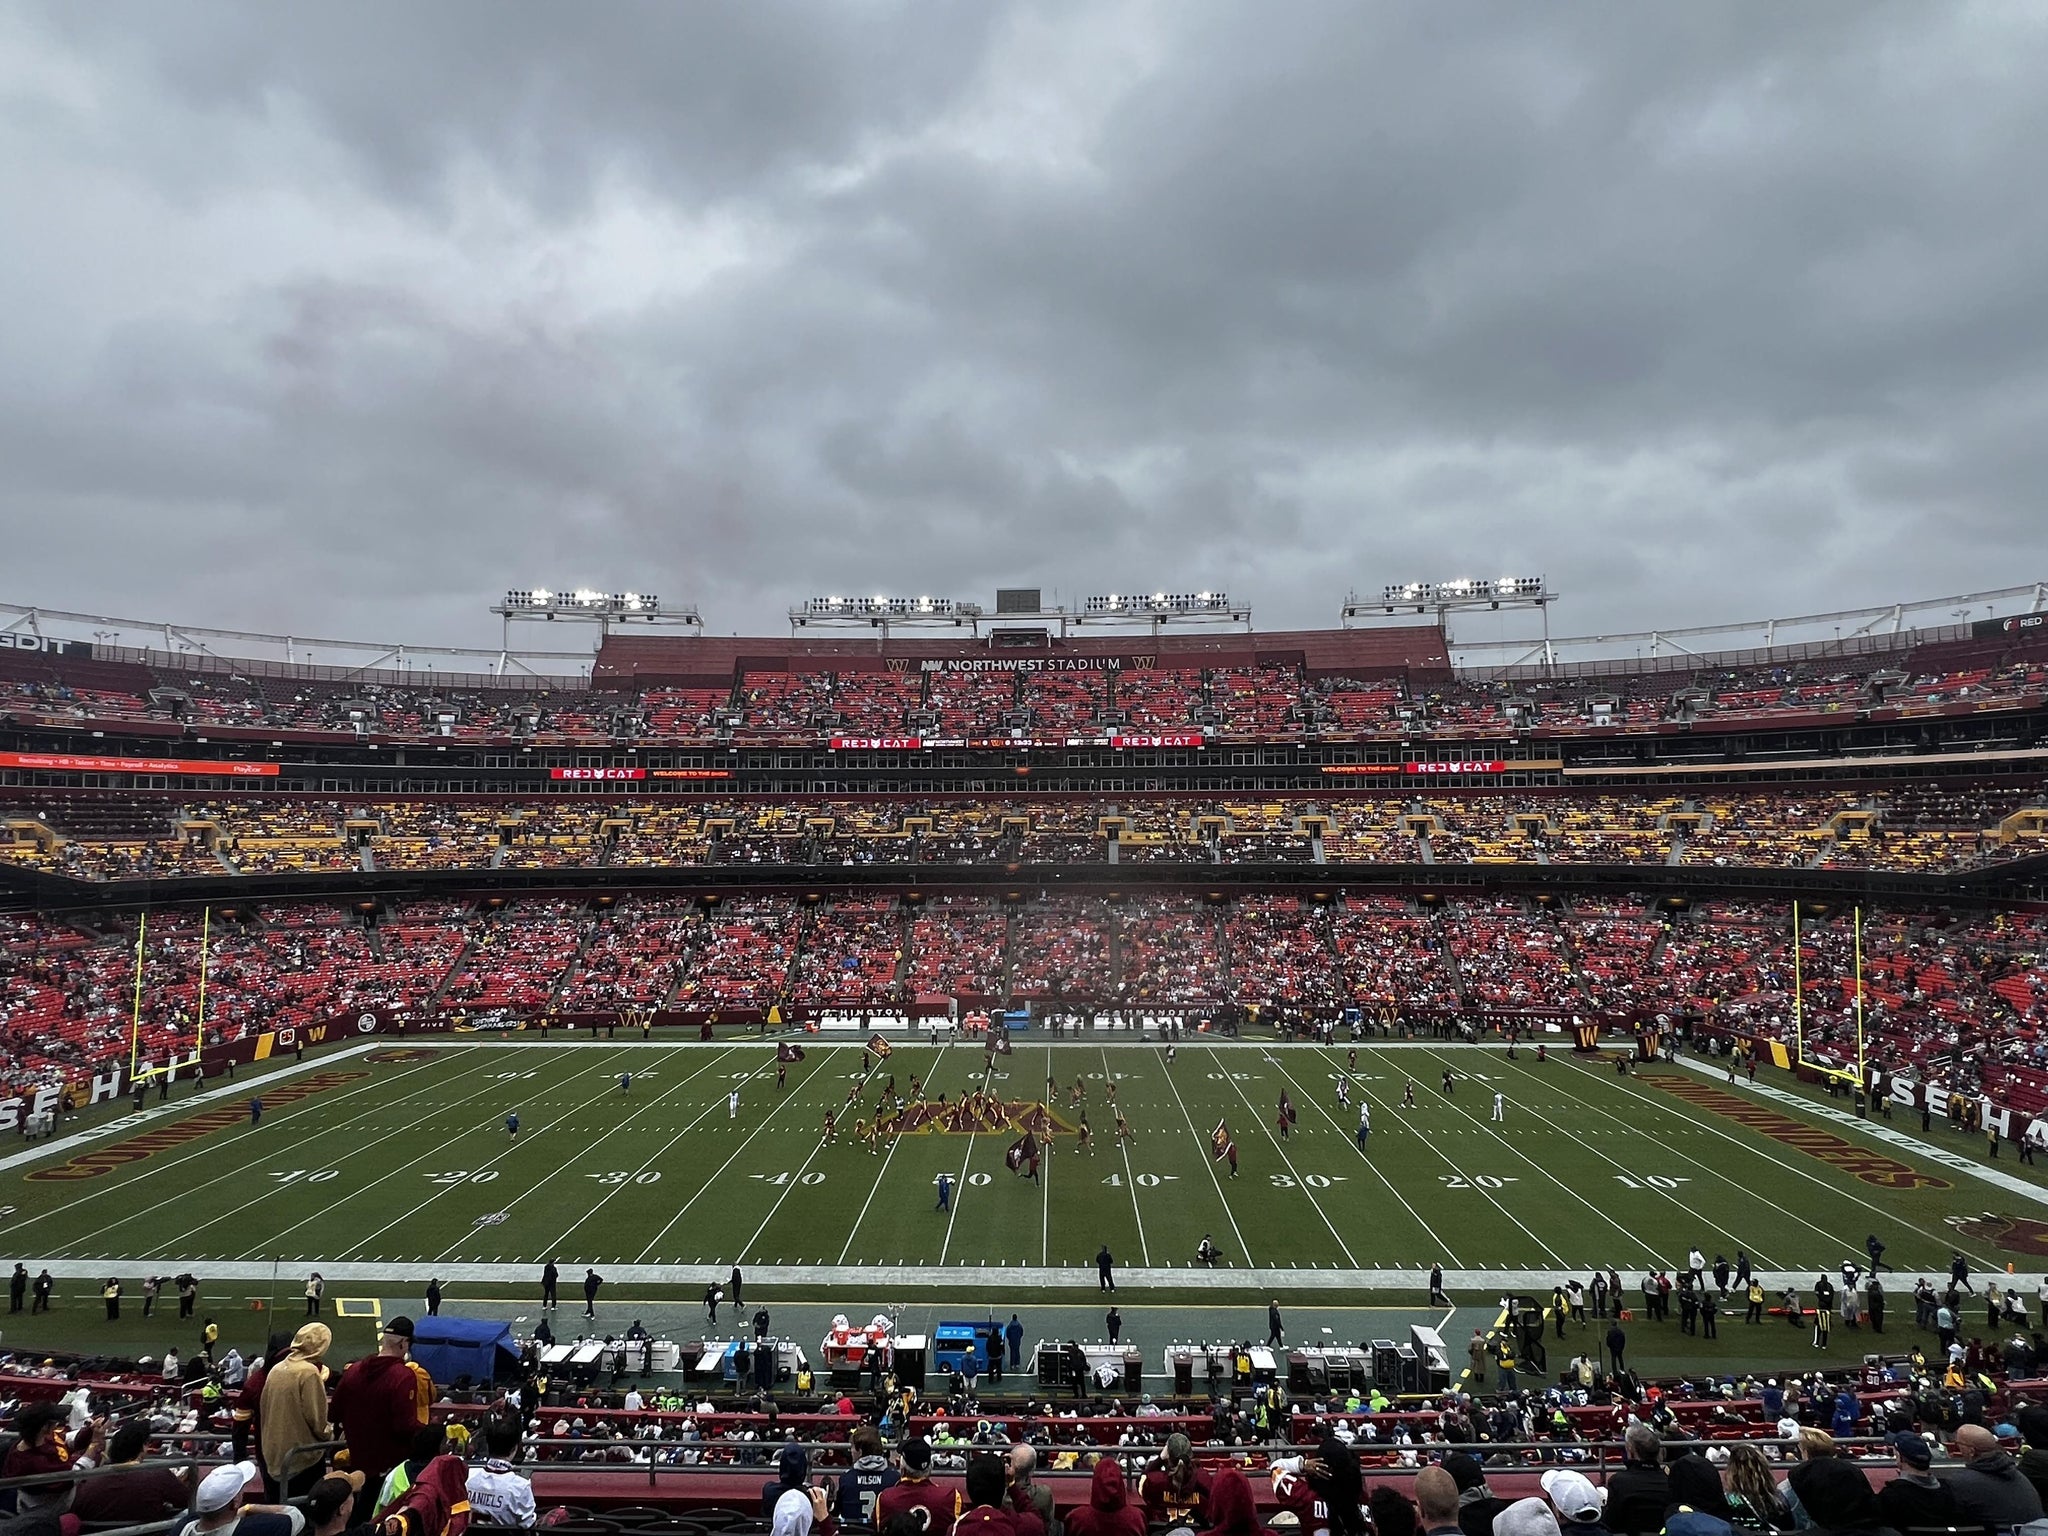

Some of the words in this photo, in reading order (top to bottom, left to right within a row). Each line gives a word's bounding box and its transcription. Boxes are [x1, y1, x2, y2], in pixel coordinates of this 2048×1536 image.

[0, 631, 71, 654] GDIT
[948, 659, 1044, 671] NORTHWEST
[1048, 657, 1120, 670] STADIUM
[842, 739, 868, 748] RED
[883, 739, 909, 748] CAT
[1122, 737, 1148, 746] RED
[1164, 737, 1191, 746] CAT
[563, 769, 591, 779] RED
[607, 769, 635, 779] CAT
[1418, 763, 1447, 773] RED
[1463, 762, 1492, 772] CAT
[273, 1168, 339, 1184] 10
[430, 1169, 499, 1185] 20
[597, 1169, 663, 1185] 30
[764, 1169, 827, 1185] 40
[1101, 1172, 1160, 1188] 40
[1269, 1172, 1332, 1188] 30
[1437, 1174, 1504, 1189] 20
[1612, 1174, 1679, 1189] 10
[857, 1475, 883, 1485] WILSON
[468, 1490, 504, 1509] DANIELS
